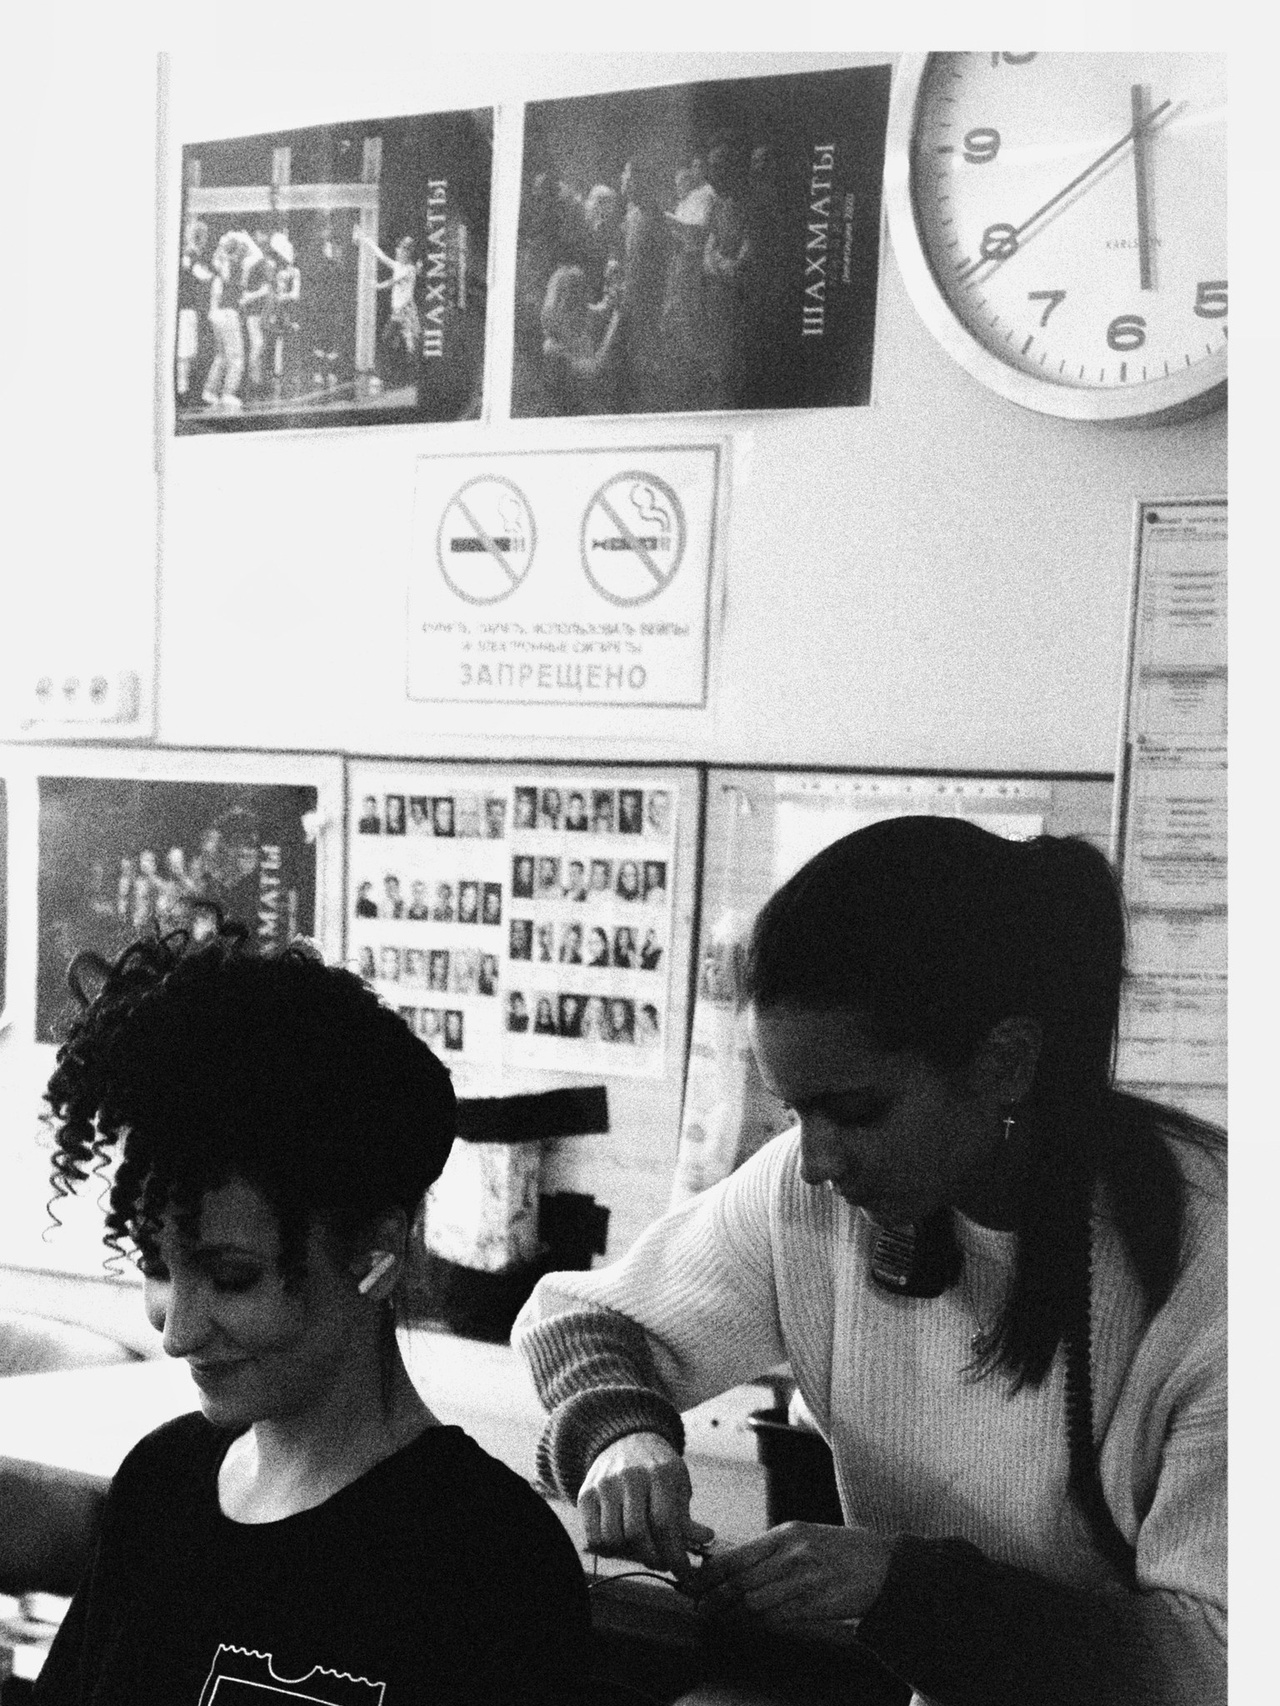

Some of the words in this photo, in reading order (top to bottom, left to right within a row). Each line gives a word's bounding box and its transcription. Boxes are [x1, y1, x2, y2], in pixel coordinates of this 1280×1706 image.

[963, 127, 1001, 164] 9
[801, 143, 835, 337] ШАХМАТЫ
[979, 222, 1019, 260] 8
[422, 179, 448, 357] ШАХМАТЫ
[1027, 289, 1067, 327] 7
[1193, 280, 1228, 319] 5
[1106, 314, 1147, 351] 6
[460, 662, 647, 692] ЗАПРЕЩЕНО
